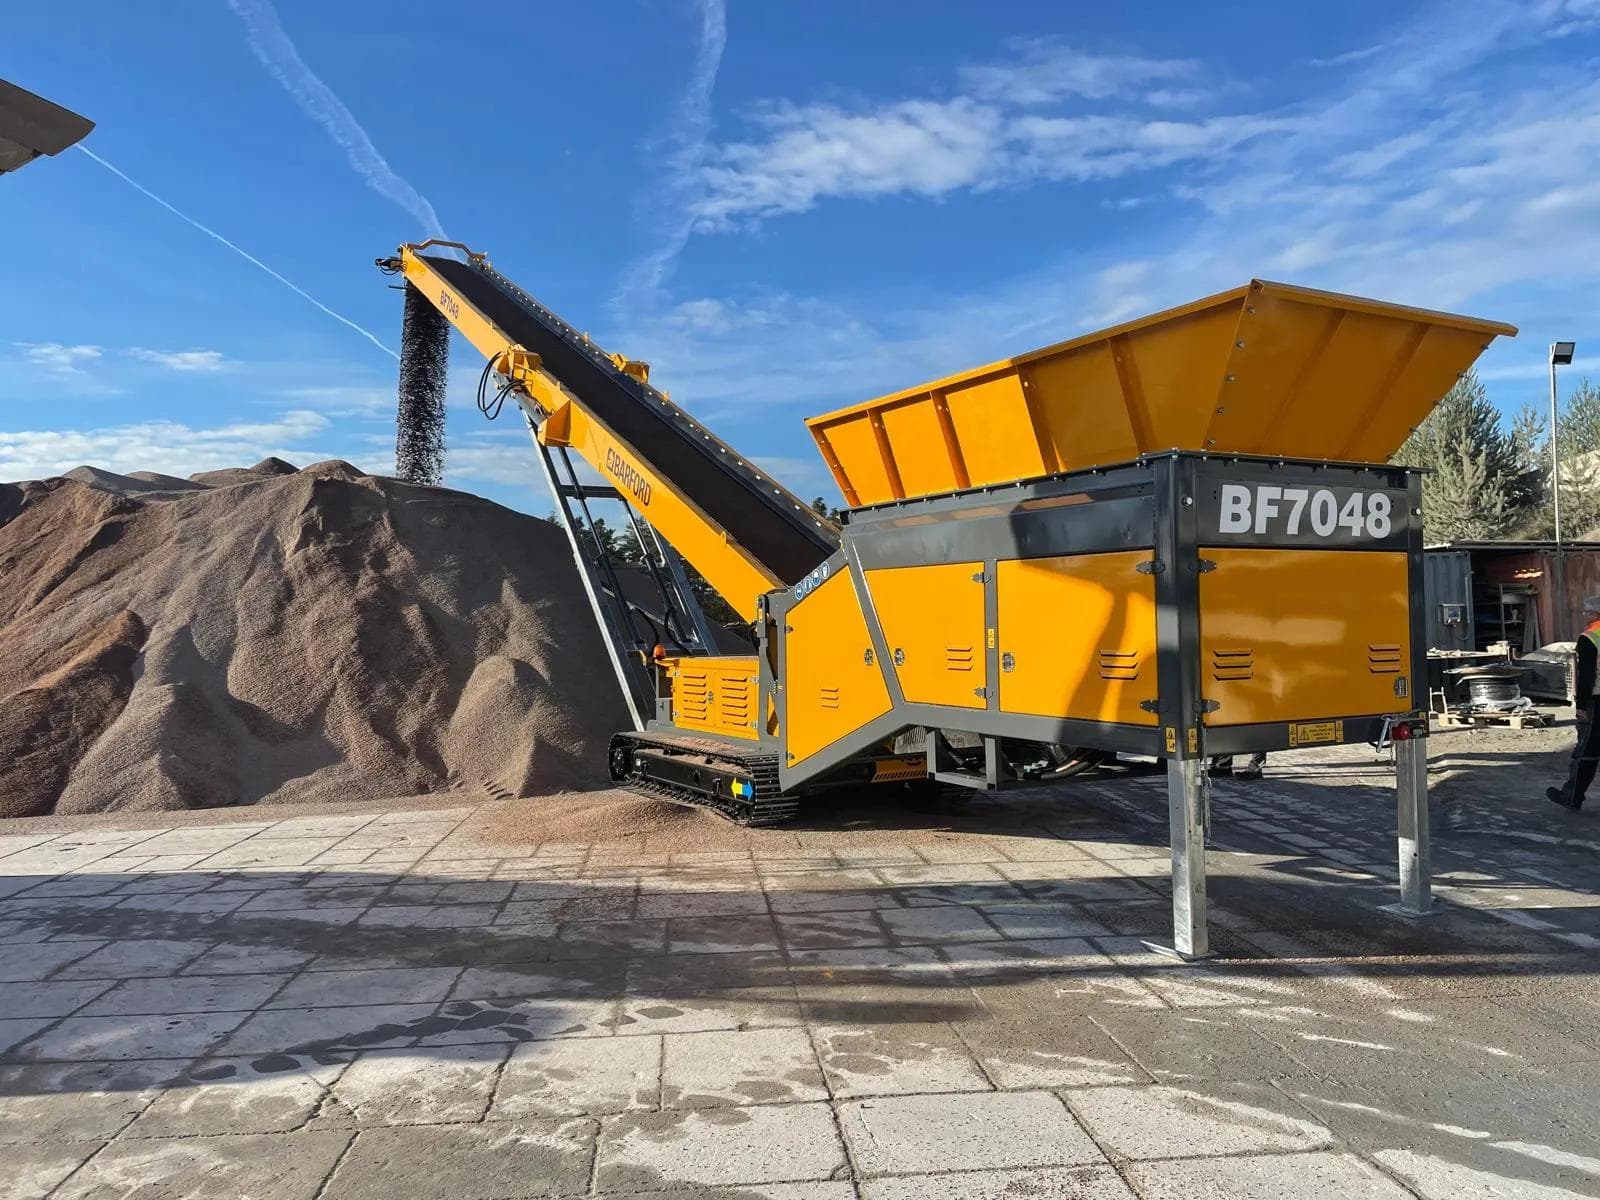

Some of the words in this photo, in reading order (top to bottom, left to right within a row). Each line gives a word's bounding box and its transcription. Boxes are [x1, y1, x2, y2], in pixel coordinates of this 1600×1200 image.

[440, 290, 459, 319] BF7048
[613, 454, 651, 507] BARFORD
[1219, 484, 1392, 539] BF7048
